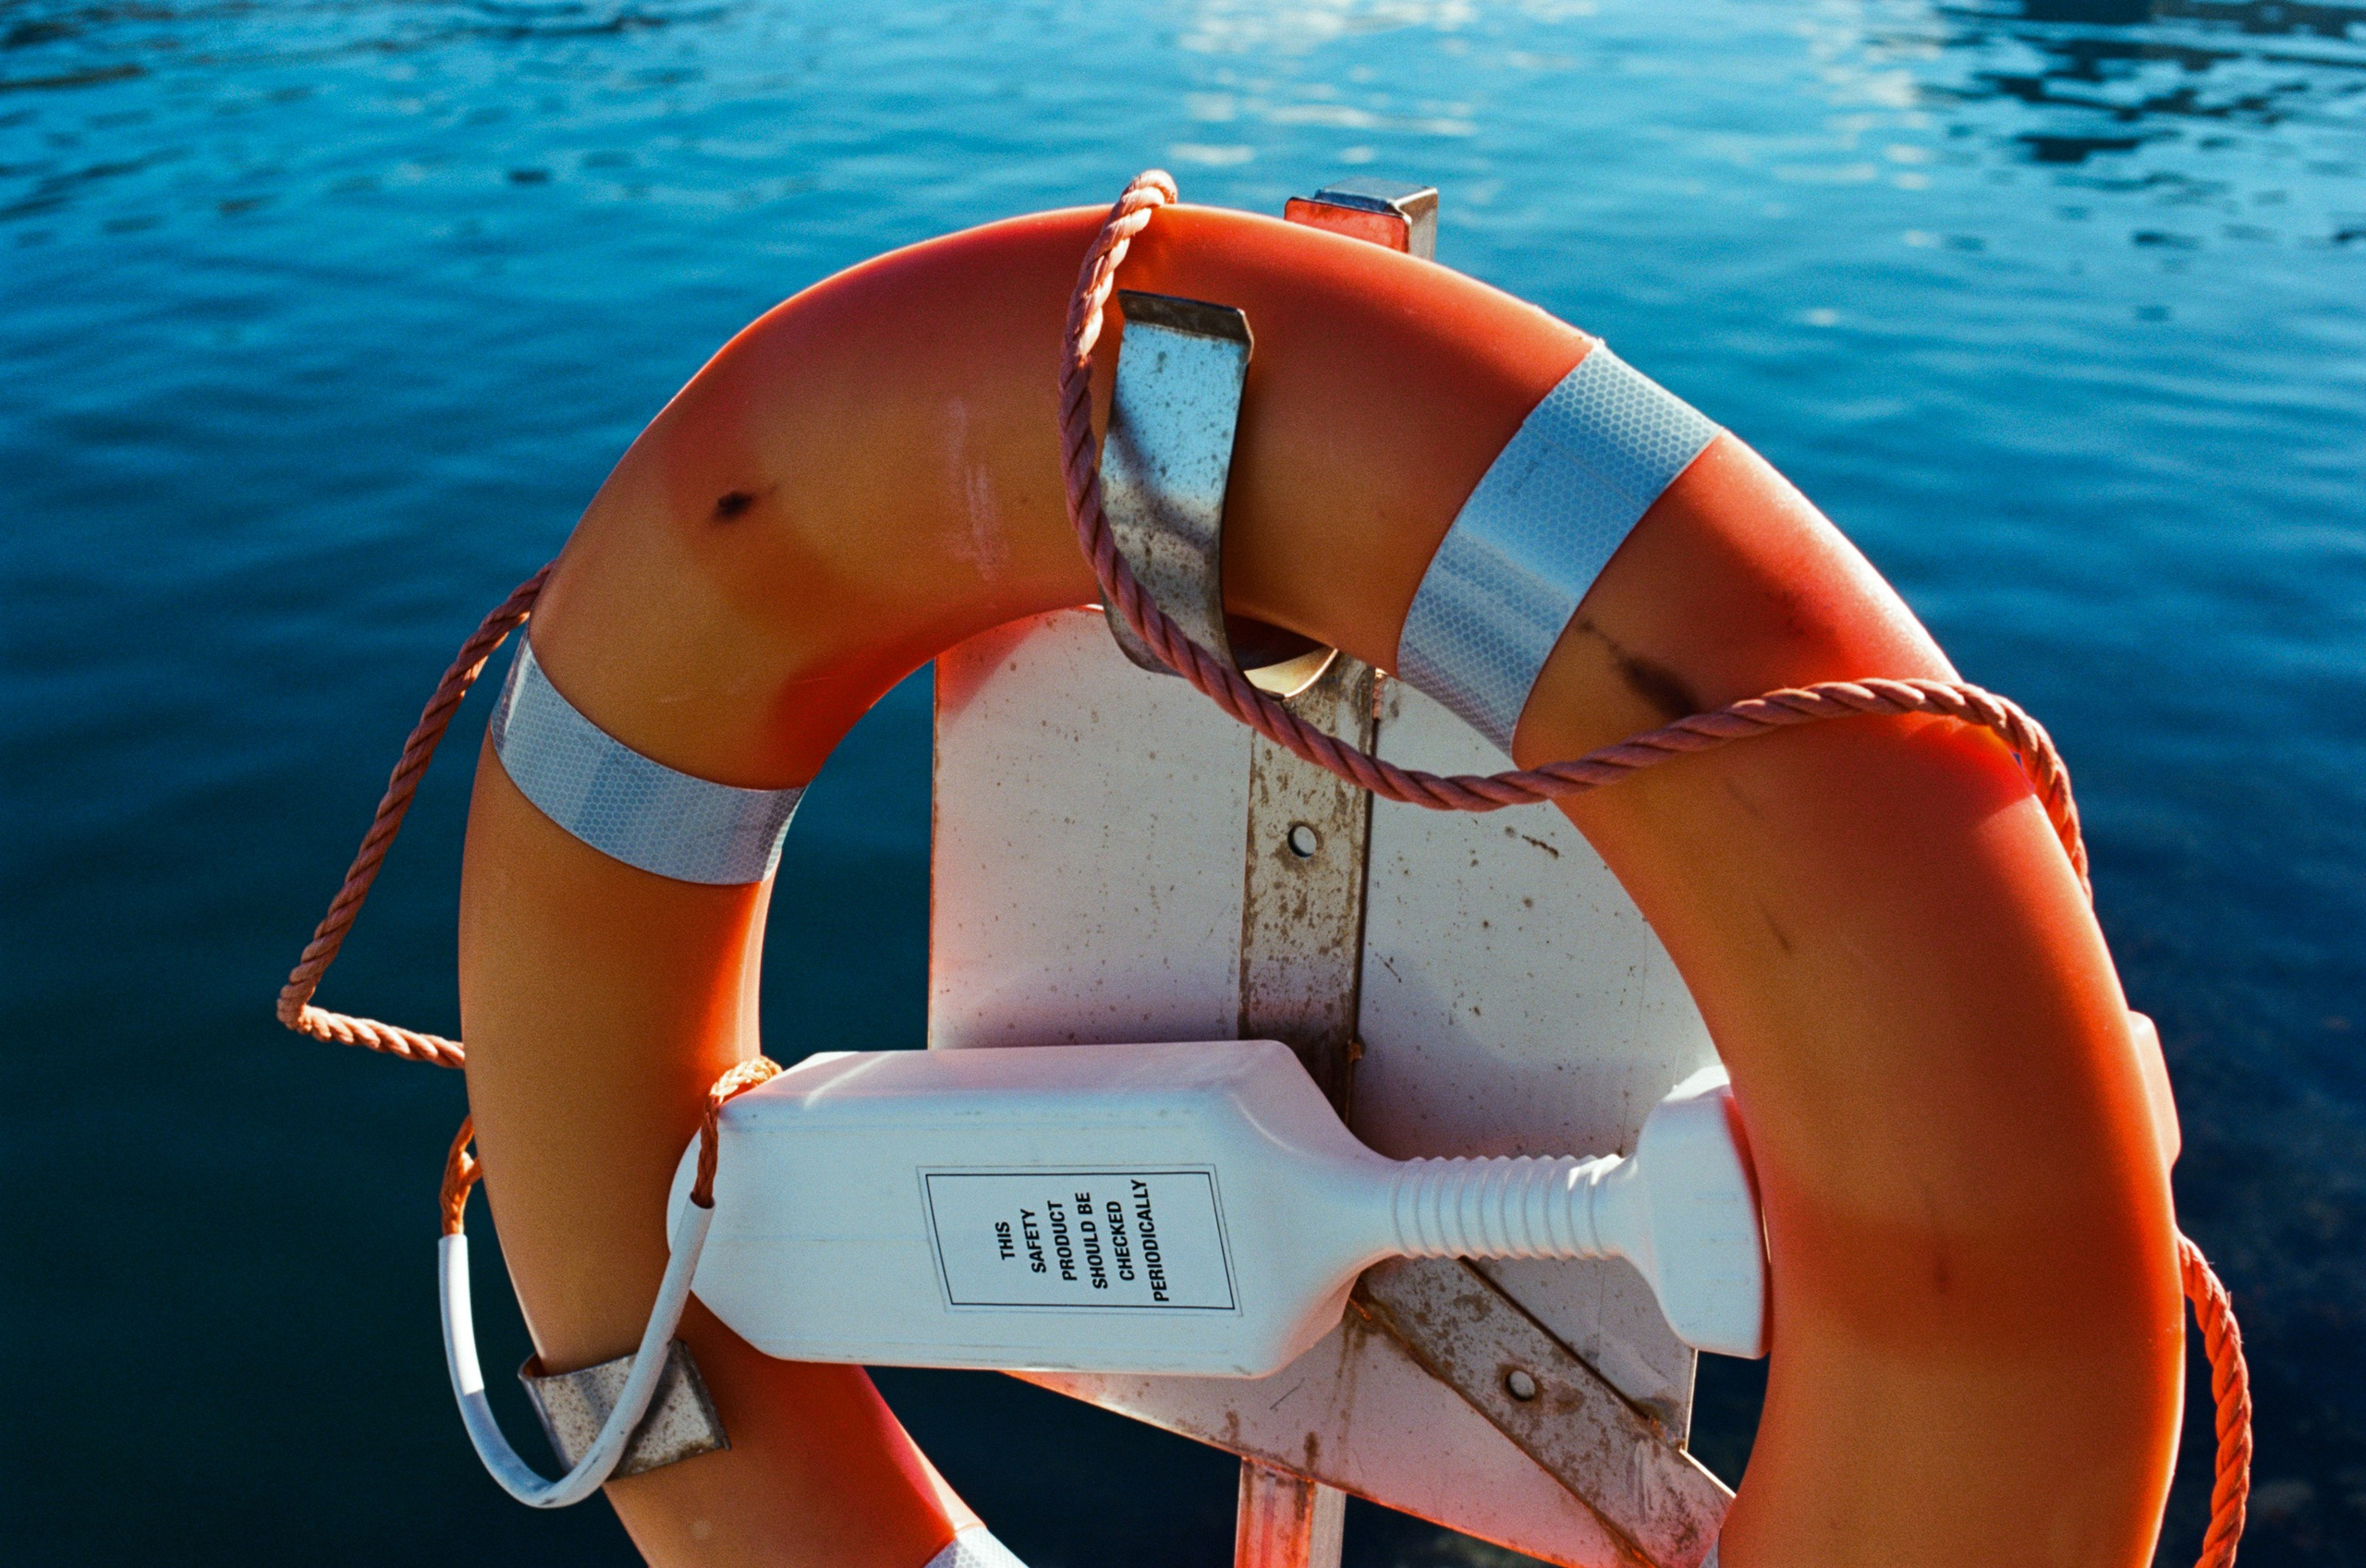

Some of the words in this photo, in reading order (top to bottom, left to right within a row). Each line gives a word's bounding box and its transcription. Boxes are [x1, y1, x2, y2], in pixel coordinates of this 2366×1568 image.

[1075, 1192, 1093, 1215] BE
[994, 1221, 1016, 1260] THIS
[1020, 1209, 1046, 1273] SAFETY
[1047, 1200, 1078, 1282] PRODUCT
[1080, 1221, 1108, 1290] SHOULD
[1105, 1201, 1135, 1282] CHECKED
[1130, 1179, 1170, 1302] PERIODICALLY
